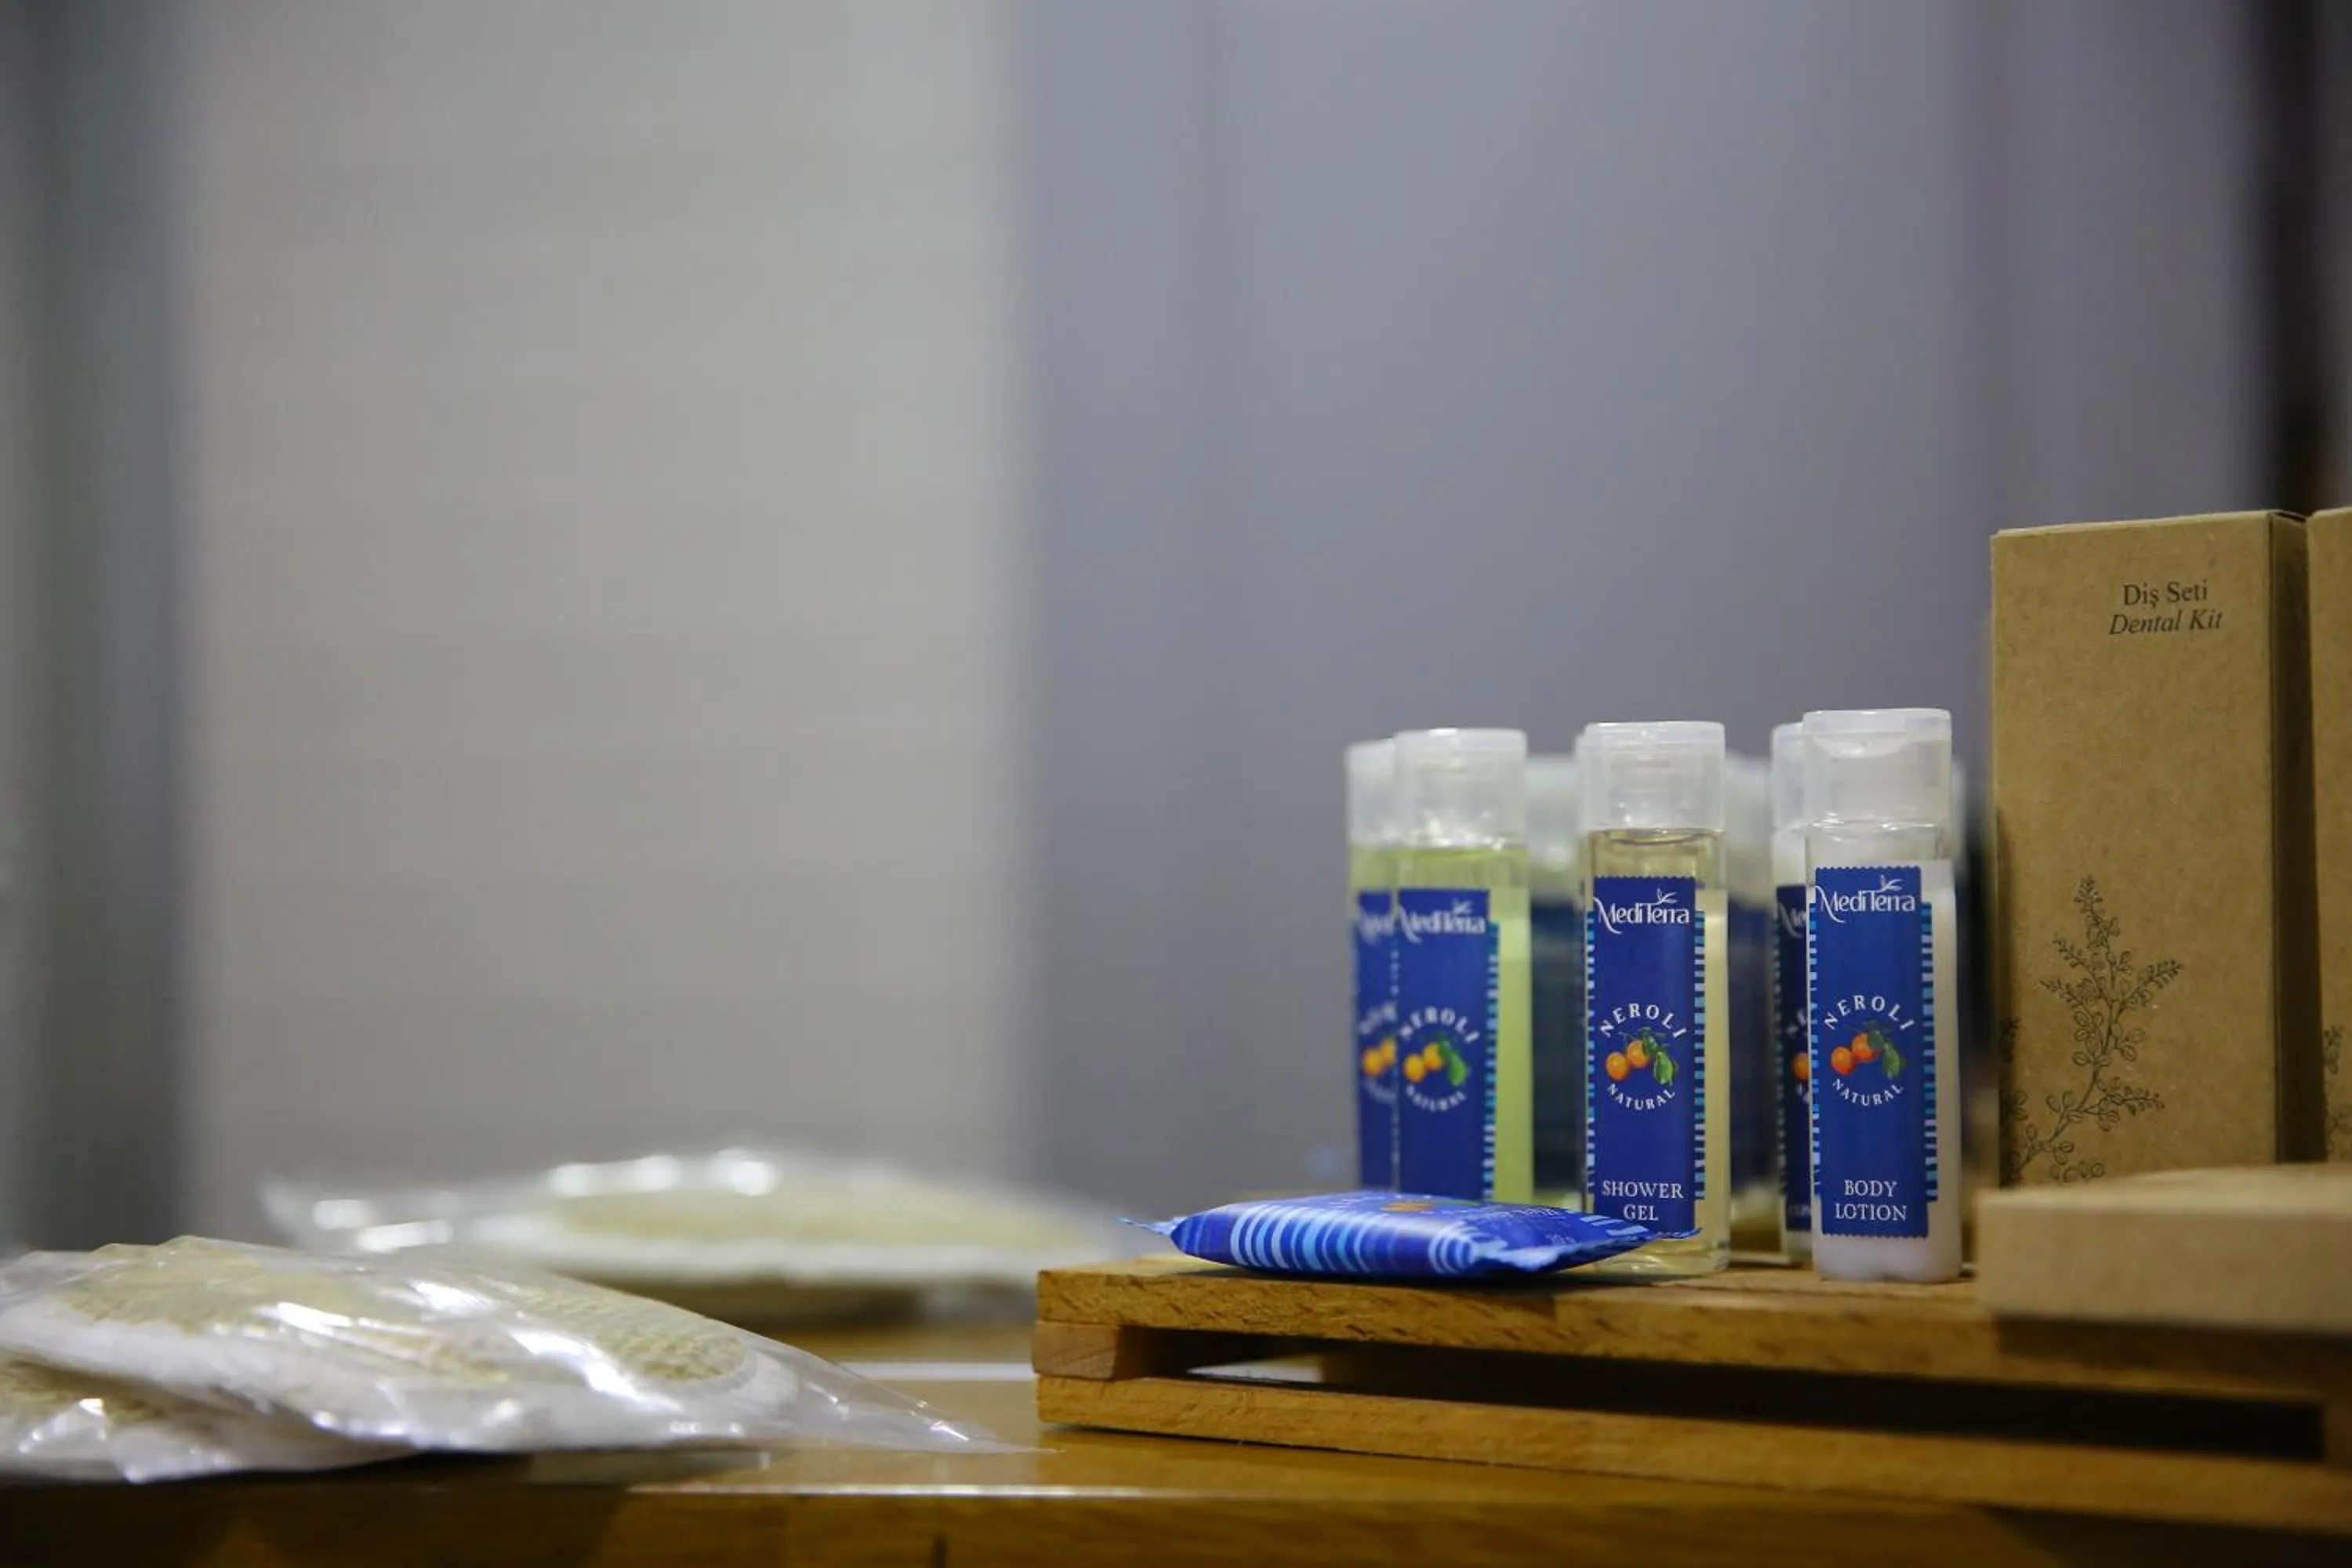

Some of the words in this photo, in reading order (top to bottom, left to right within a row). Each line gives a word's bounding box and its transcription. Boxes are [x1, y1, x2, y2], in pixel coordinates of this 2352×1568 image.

[2123, 583, 2159, 608] Diş
[2167, 579, 2208, 603] Seti
[2108, 609, 2183, 635] Dental
[2190, 608, 2222, 630] Kit
[1593, 896, 1690, 935] MediTerra
[1815, 885, 1915, 924] MediTerra
[1599, 1003, 1686, 1038] NEROLI
[1824, 994, 1915, 1029] NEROLI
[1608, 1083, 1675, 1111] NATURAL
[1832, 1078, 1904, 1106] NATURAL
[1602, 1180, 1684, 1199] SHOWER
[1844, 1179, 1897, 1197] BODY
[1624, 1203, 1659, 1221] GEL
[1835, 1203, 1907, 1221] LOTION
